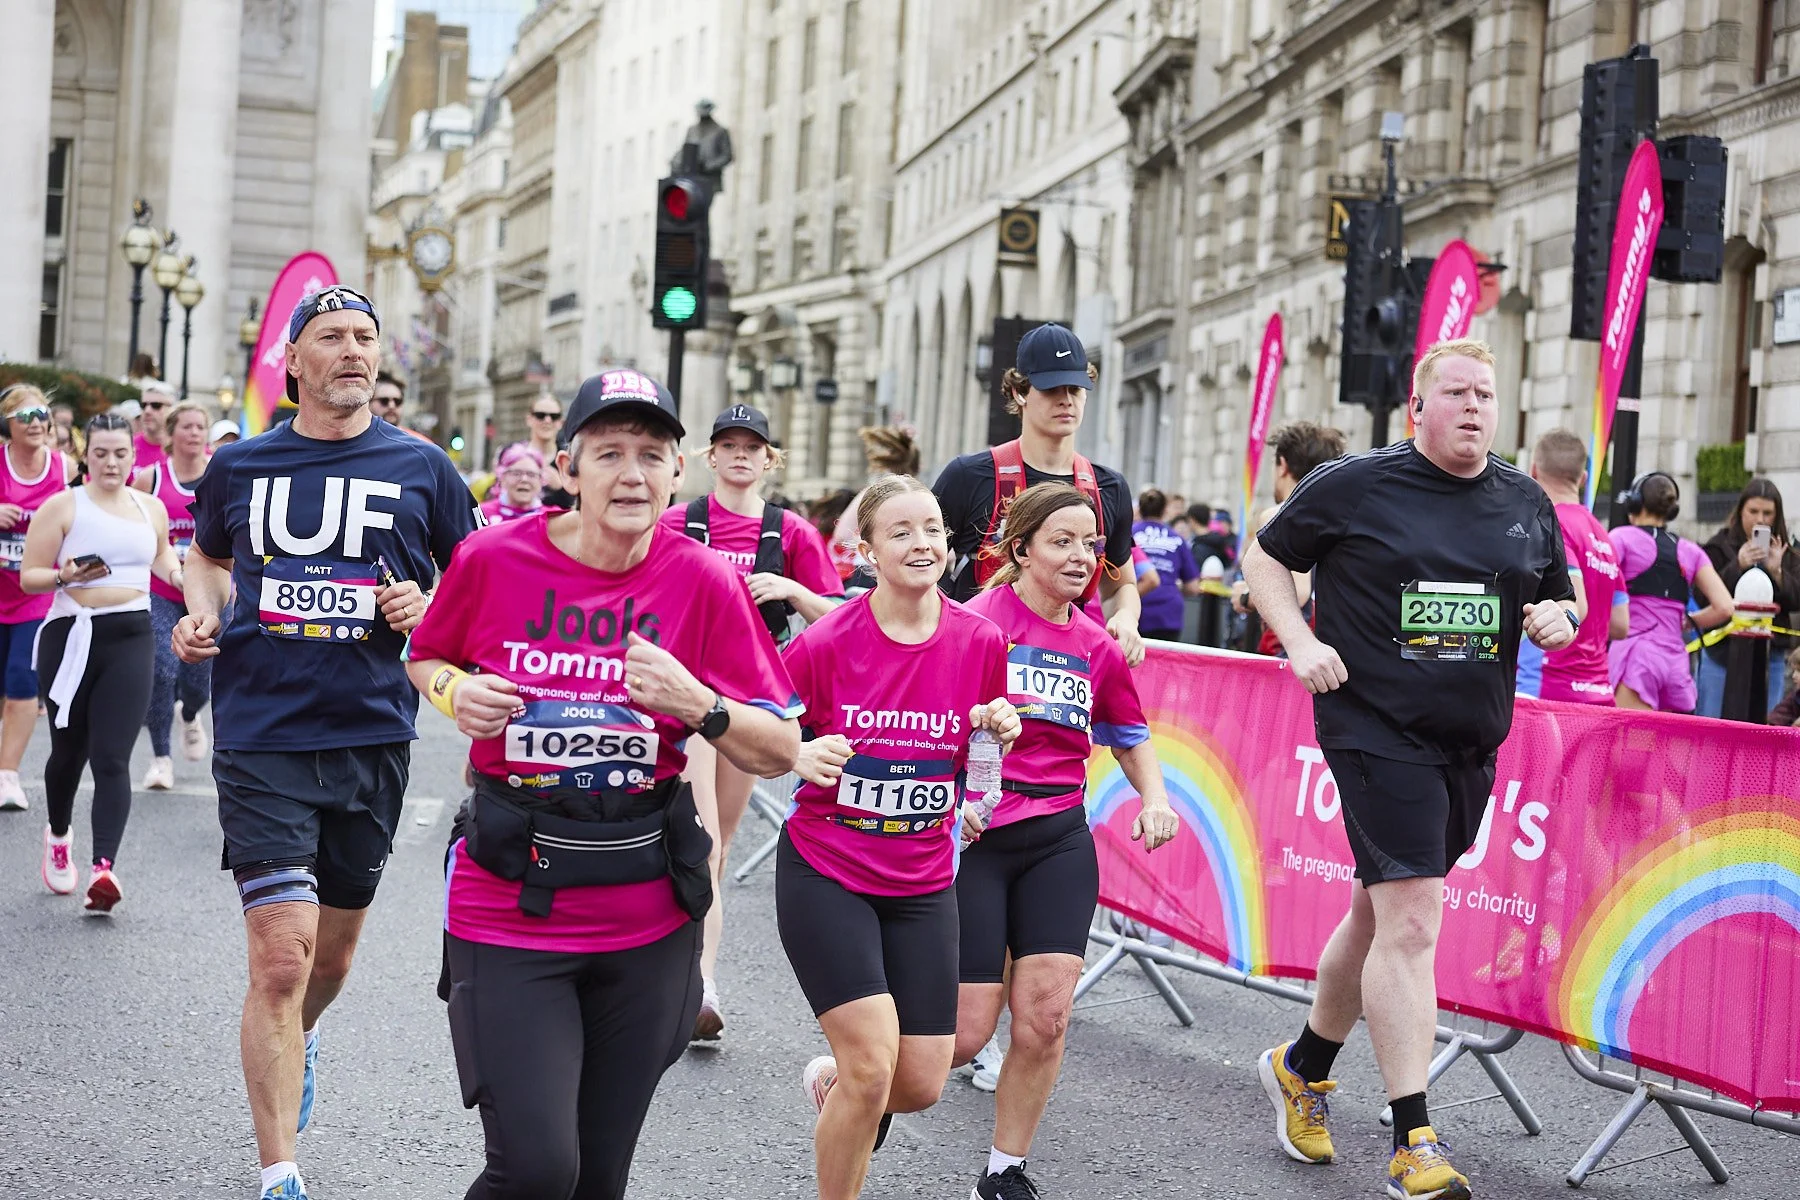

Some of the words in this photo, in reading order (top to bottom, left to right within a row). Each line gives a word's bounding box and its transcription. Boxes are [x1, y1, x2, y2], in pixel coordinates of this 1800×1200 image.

[1606, 187, 1651, 350] Tommy's
[304, 565, 333, 575] MATT
[276, 583, 358, 615] 8905
[525, 589, 662, 649] Jools
[1408, 600, 1494, 627] 23730
[1042, 652, 1068, 666] HELEN
[1478, 652, 1495, 660] 23730
[579, 691, 601, 702] and
[1016, 667, 1087, 705] 10736
[560, 706, 606, 720] JOOLS
[841, 704, 961, 739] Tommy's
[517, 730, 648, 759] 10256
[896, 739, 913, 747] and
[914, 740, 936, 751] baby
[889, 765, 916, 774] BETH
[849, 779, 949, 811] 11169
[1282, 846, 1303, 871] The
[1466, 885, 1537, 925] charity
